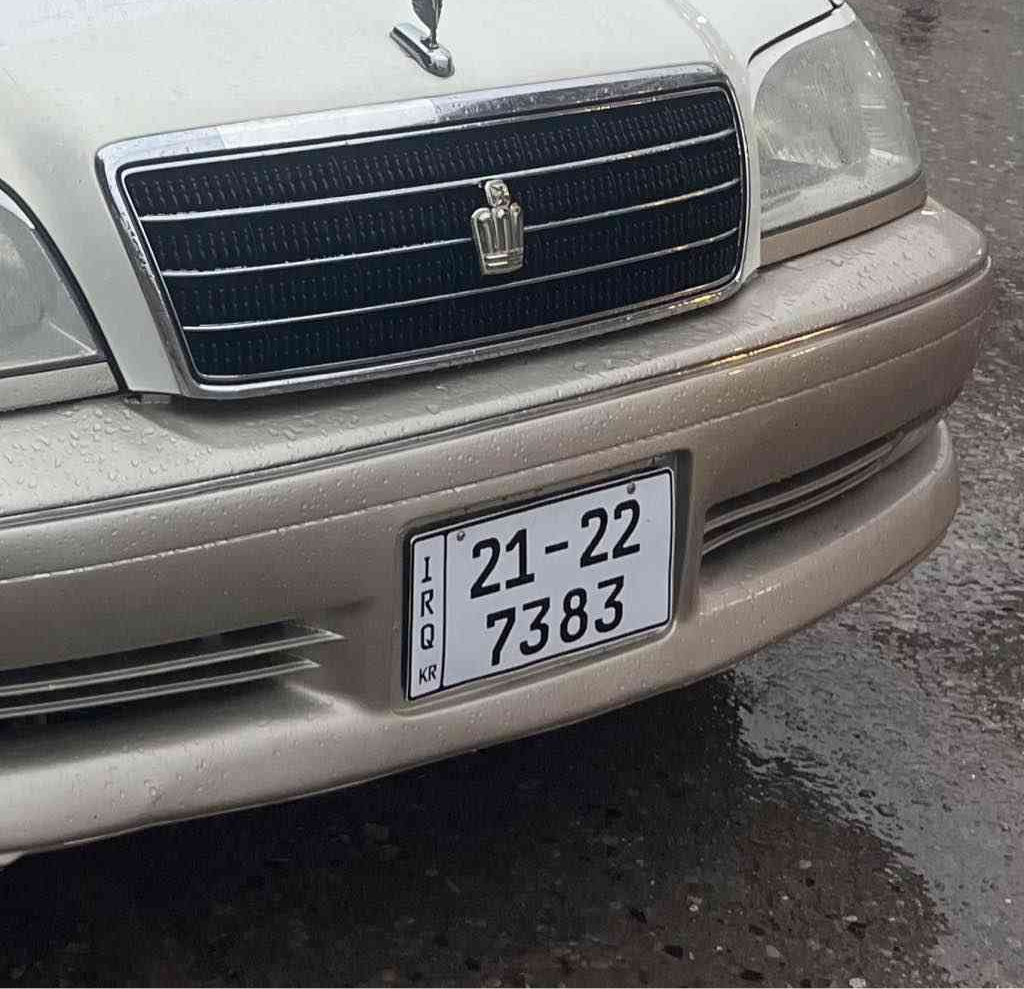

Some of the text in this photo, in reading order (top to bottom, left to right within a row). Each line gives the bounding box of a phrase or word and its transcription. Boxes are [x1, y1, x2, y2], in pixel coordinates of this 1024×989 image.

[470, 499, 640, 599] 21-22
[420, 556, 434, 650] IRQ
[486, 575, 624, 666] 7383
[418, 664, 437, 684] KR
